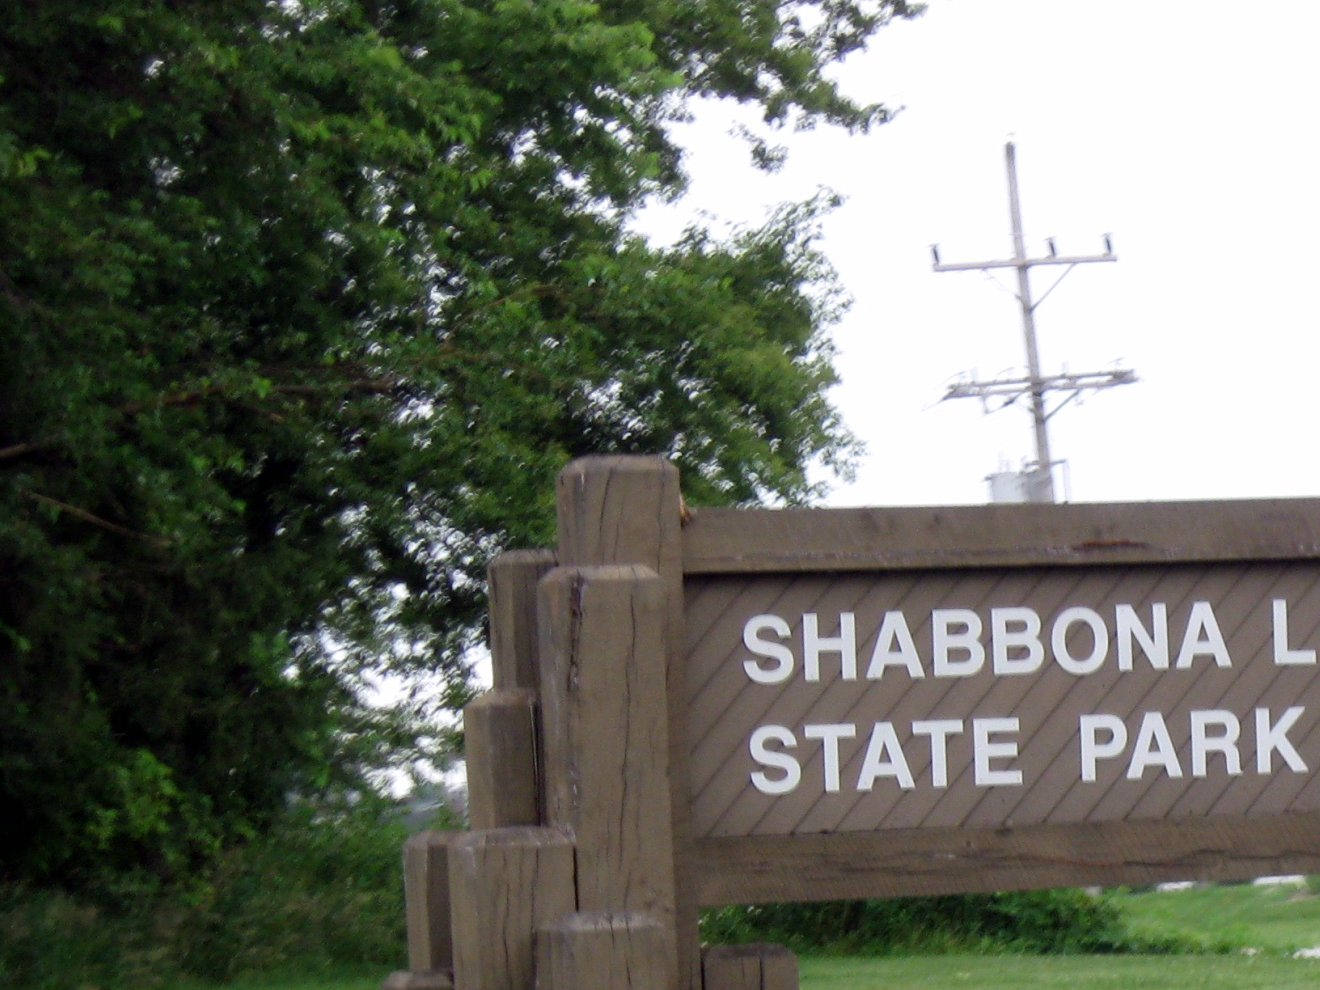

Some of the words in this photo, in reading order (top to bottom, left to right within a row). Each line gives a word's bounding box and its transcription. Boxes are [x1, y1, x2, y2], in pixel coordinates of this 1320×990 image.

[742, 601, 1233, 685] SHABBONA
[749, 716, 1024, 795] STATE
[1078, 705, 1310, 783] PARK
